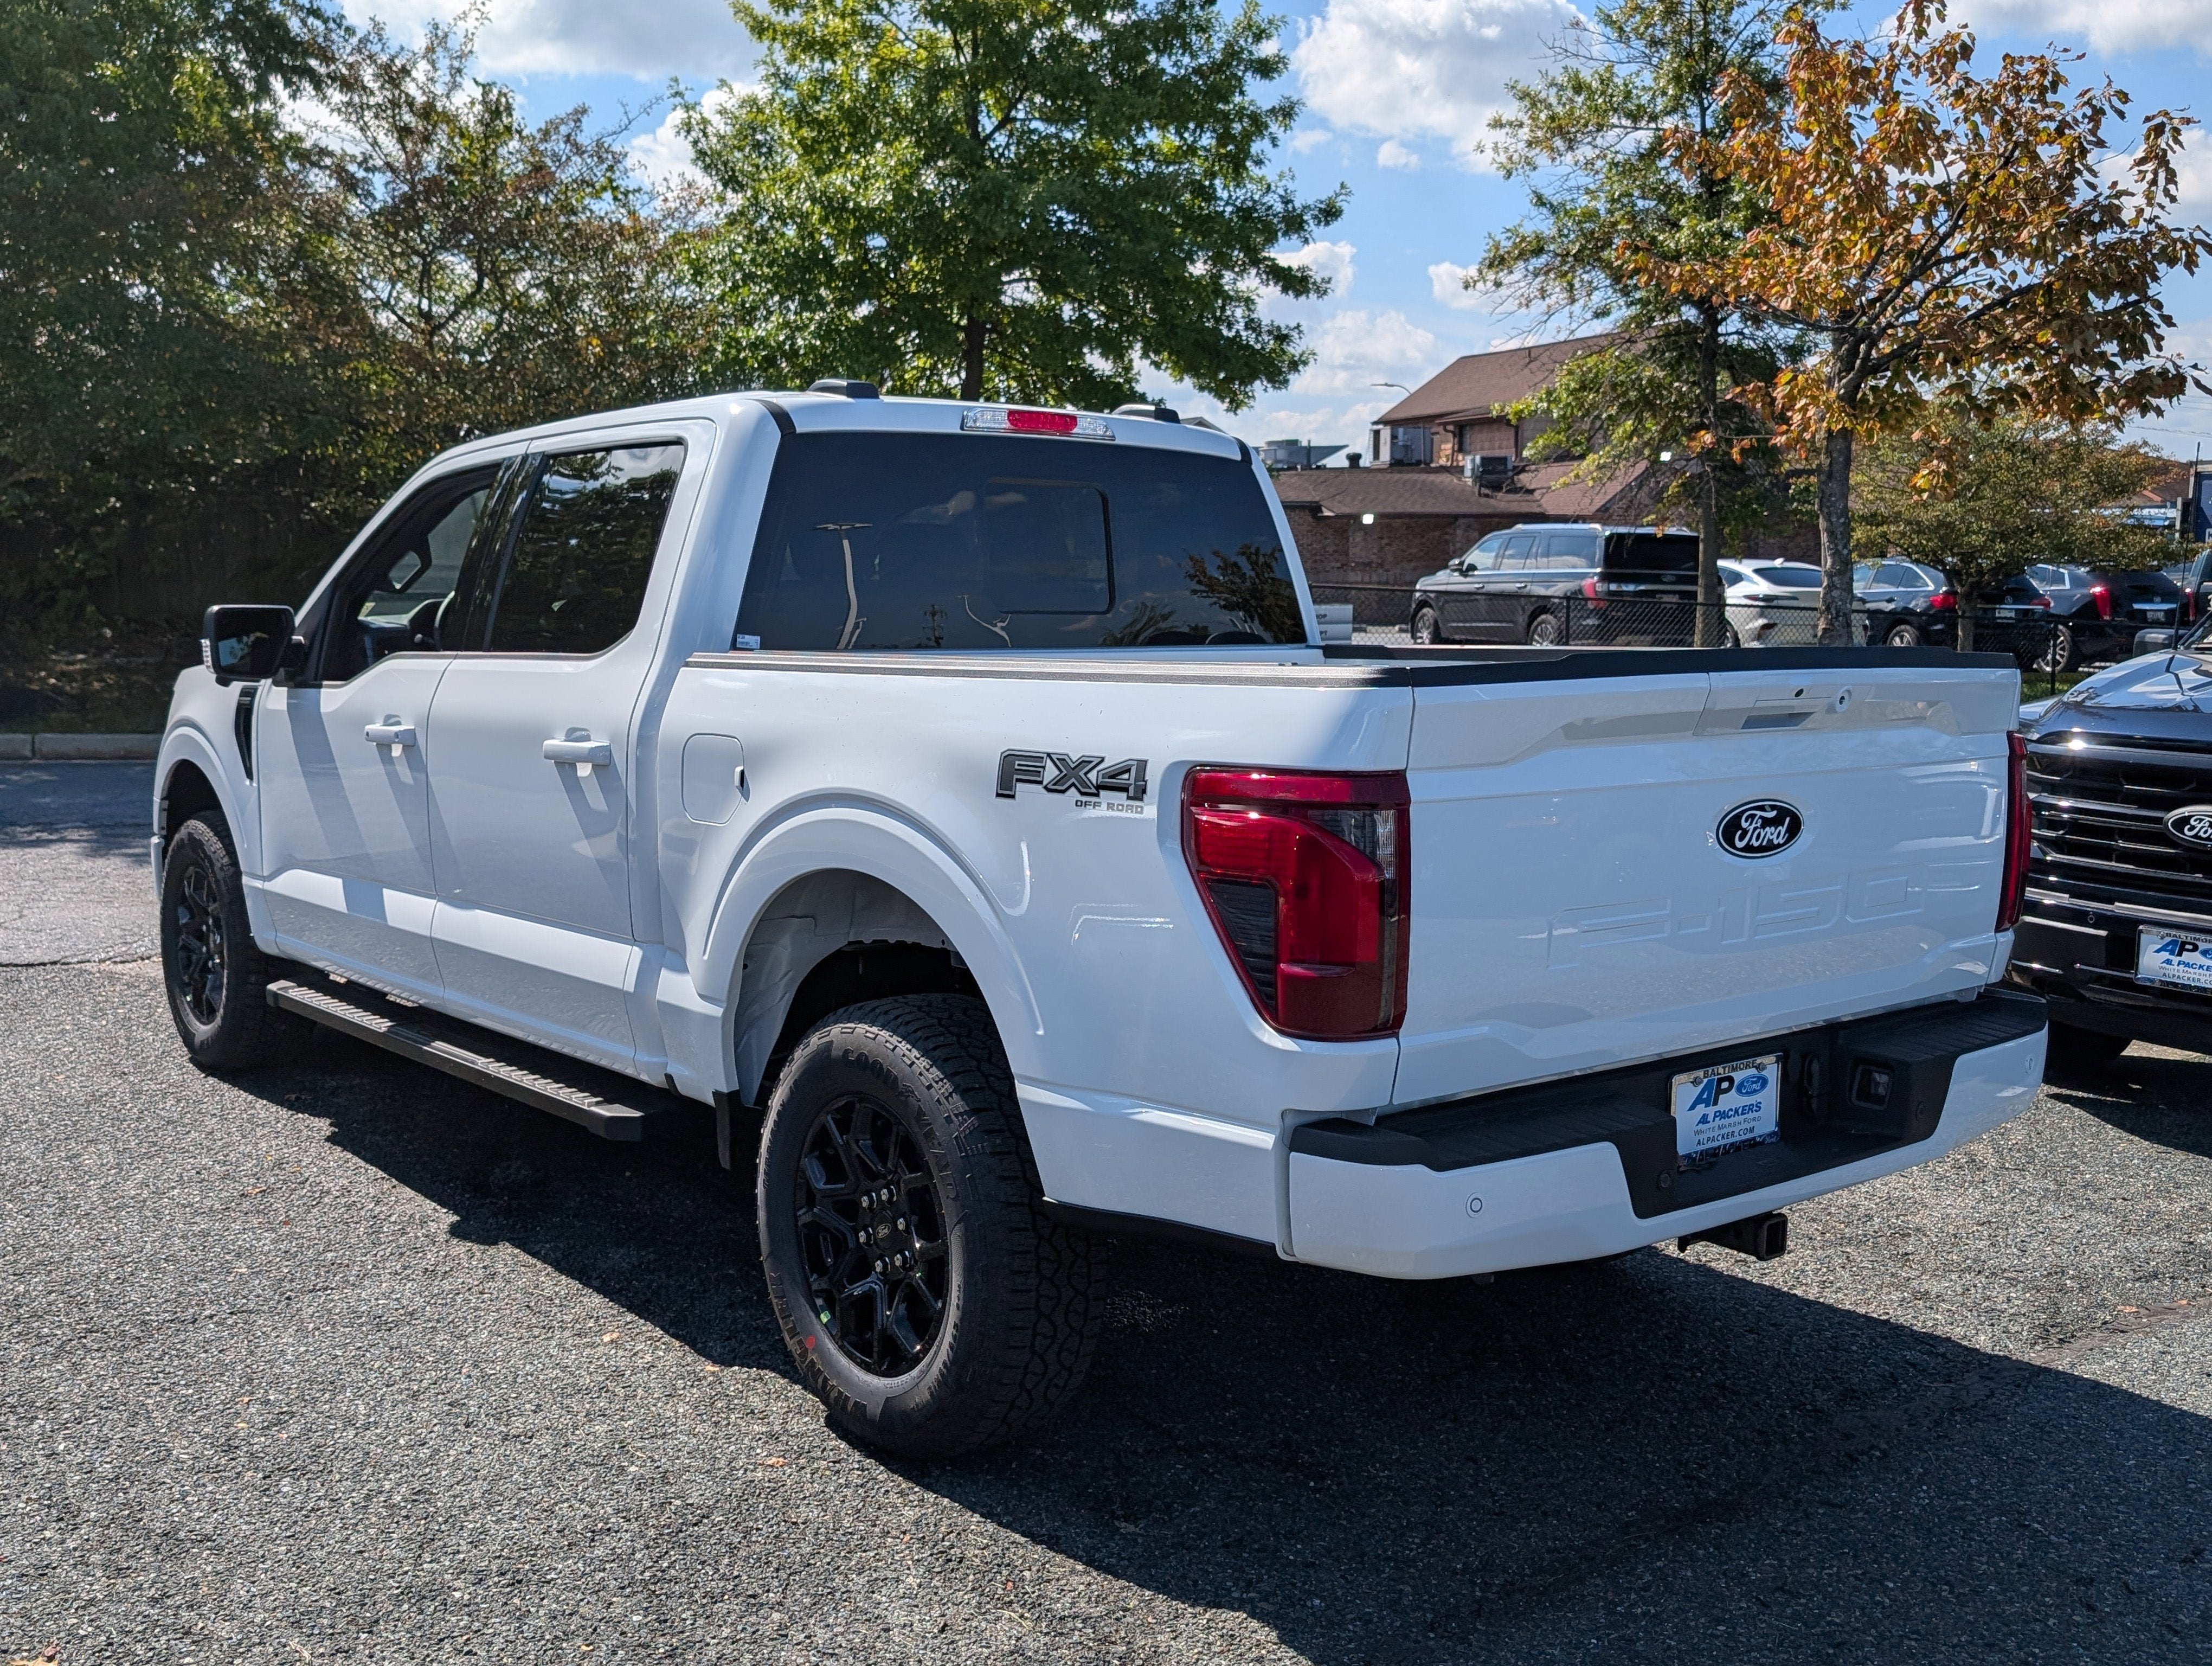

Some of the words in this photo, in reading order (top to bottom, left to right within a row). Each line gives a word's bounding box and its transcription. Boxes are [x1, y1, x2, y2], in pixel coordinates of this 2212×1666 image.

[995, 748, 1149, 801] FX4
[1075, 799, 1102, 809] OFF
[1107, 802, 1144, 814] ROAD
[1735, 810, 1790, 848] Ford
[2152, 939, 2199, 957] AP
[1702, 1059, 1758, 1079] BALTIMORE
[1687, 1075, 1735, 1112] AP
[1695, 1113, 1711, 1127] AL
[1712, 1100, 1762, 1122] PACKER'S
[1694, 1126, 1716, 1137] WHITE
[1718, 1121, 1742, 1131] MARSH
[1743, 1116, 1761, 1124] FORD
[1696, 1126, 1755, 1147] ALPACKER.COM
